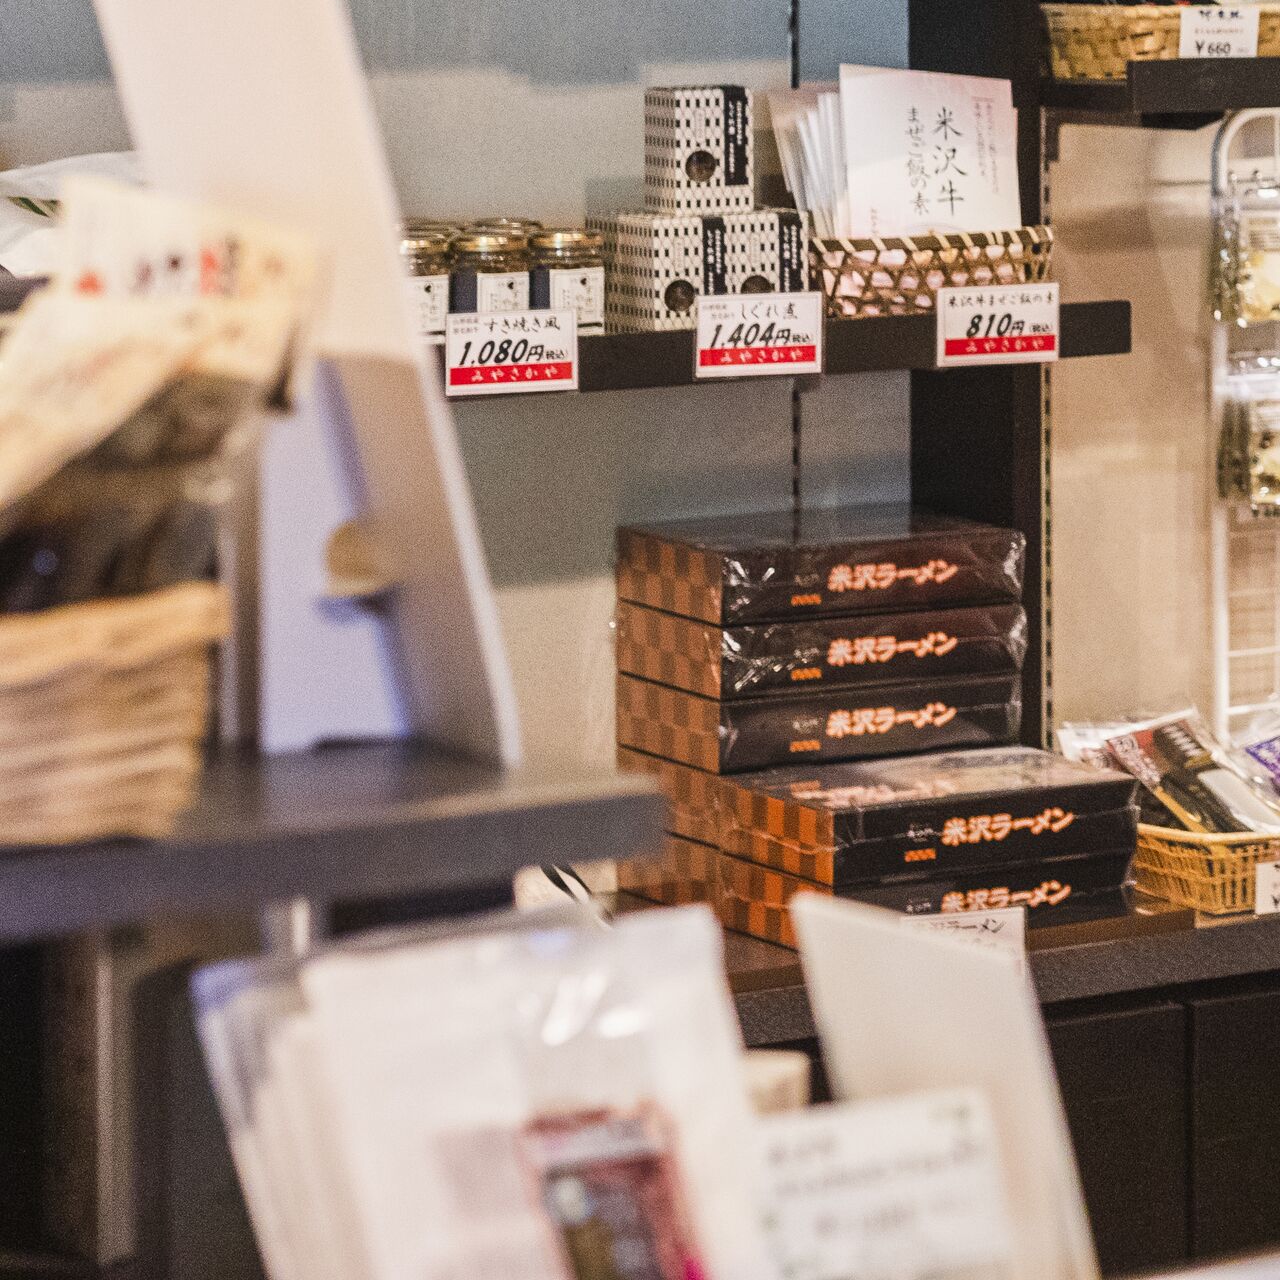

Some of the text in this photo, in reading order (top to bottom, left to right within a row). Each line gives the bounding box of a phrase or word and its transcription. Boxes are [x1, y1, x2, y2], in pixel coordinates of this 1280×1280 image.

[905, 107, 930, 216] まぜご飯の素
[932, 106, 968, 216] 米沢牛
[484, 316, 561, 334] すき焼き風
[741, 301, 798, 320] しぐれ煮
[966, 312, 1025, 338] 810円
[827, 559, 959, 593] 米沢ラーメン
[827, 631, 959, 667] 米沢ラーメン
[825, 702, 958, 739] 米沢ラーメン
[941, 807, 1075, 847] 米沢ラーメン
[940, 879, 1072, 913] 米沢ラーメン
